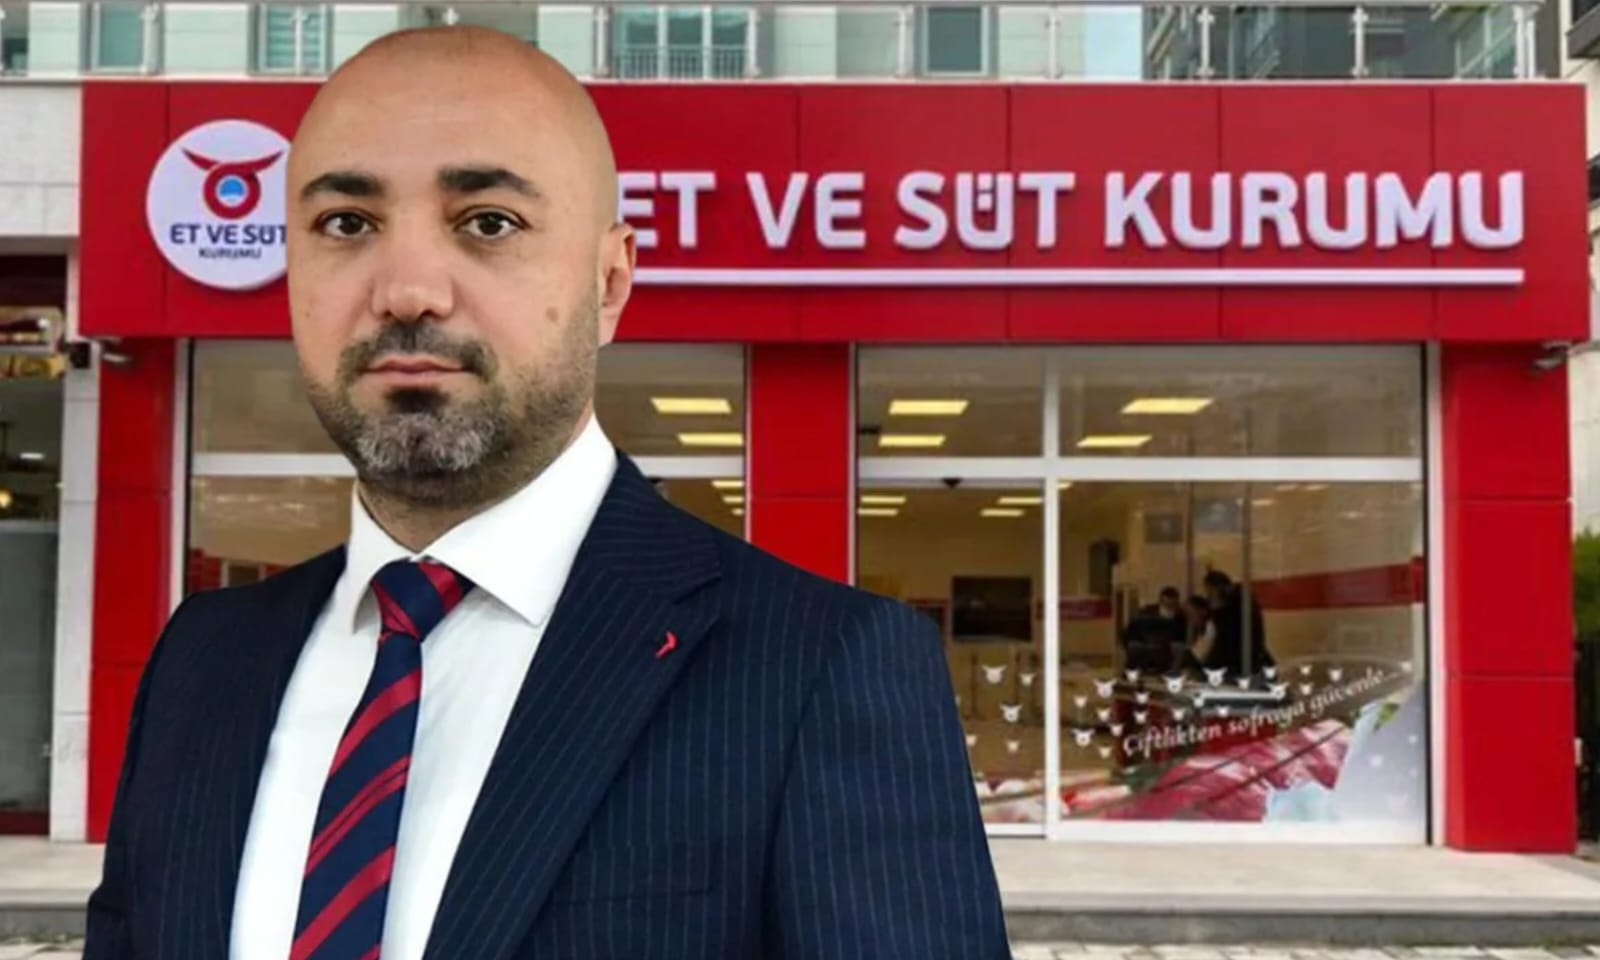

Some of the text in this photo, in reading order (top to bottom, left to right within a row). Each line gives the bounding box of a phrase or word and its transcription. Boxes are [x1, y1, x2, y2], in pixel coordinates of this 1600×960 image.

[618, 171, 1525, 249] ET VE SÜT KURUMU
[170, 224, 200, 244] ET
[206, 224, 239, 244] VE
[198, 247, 262, 259] KURUMU
[1228, 700, 1305, 736] sofraya
